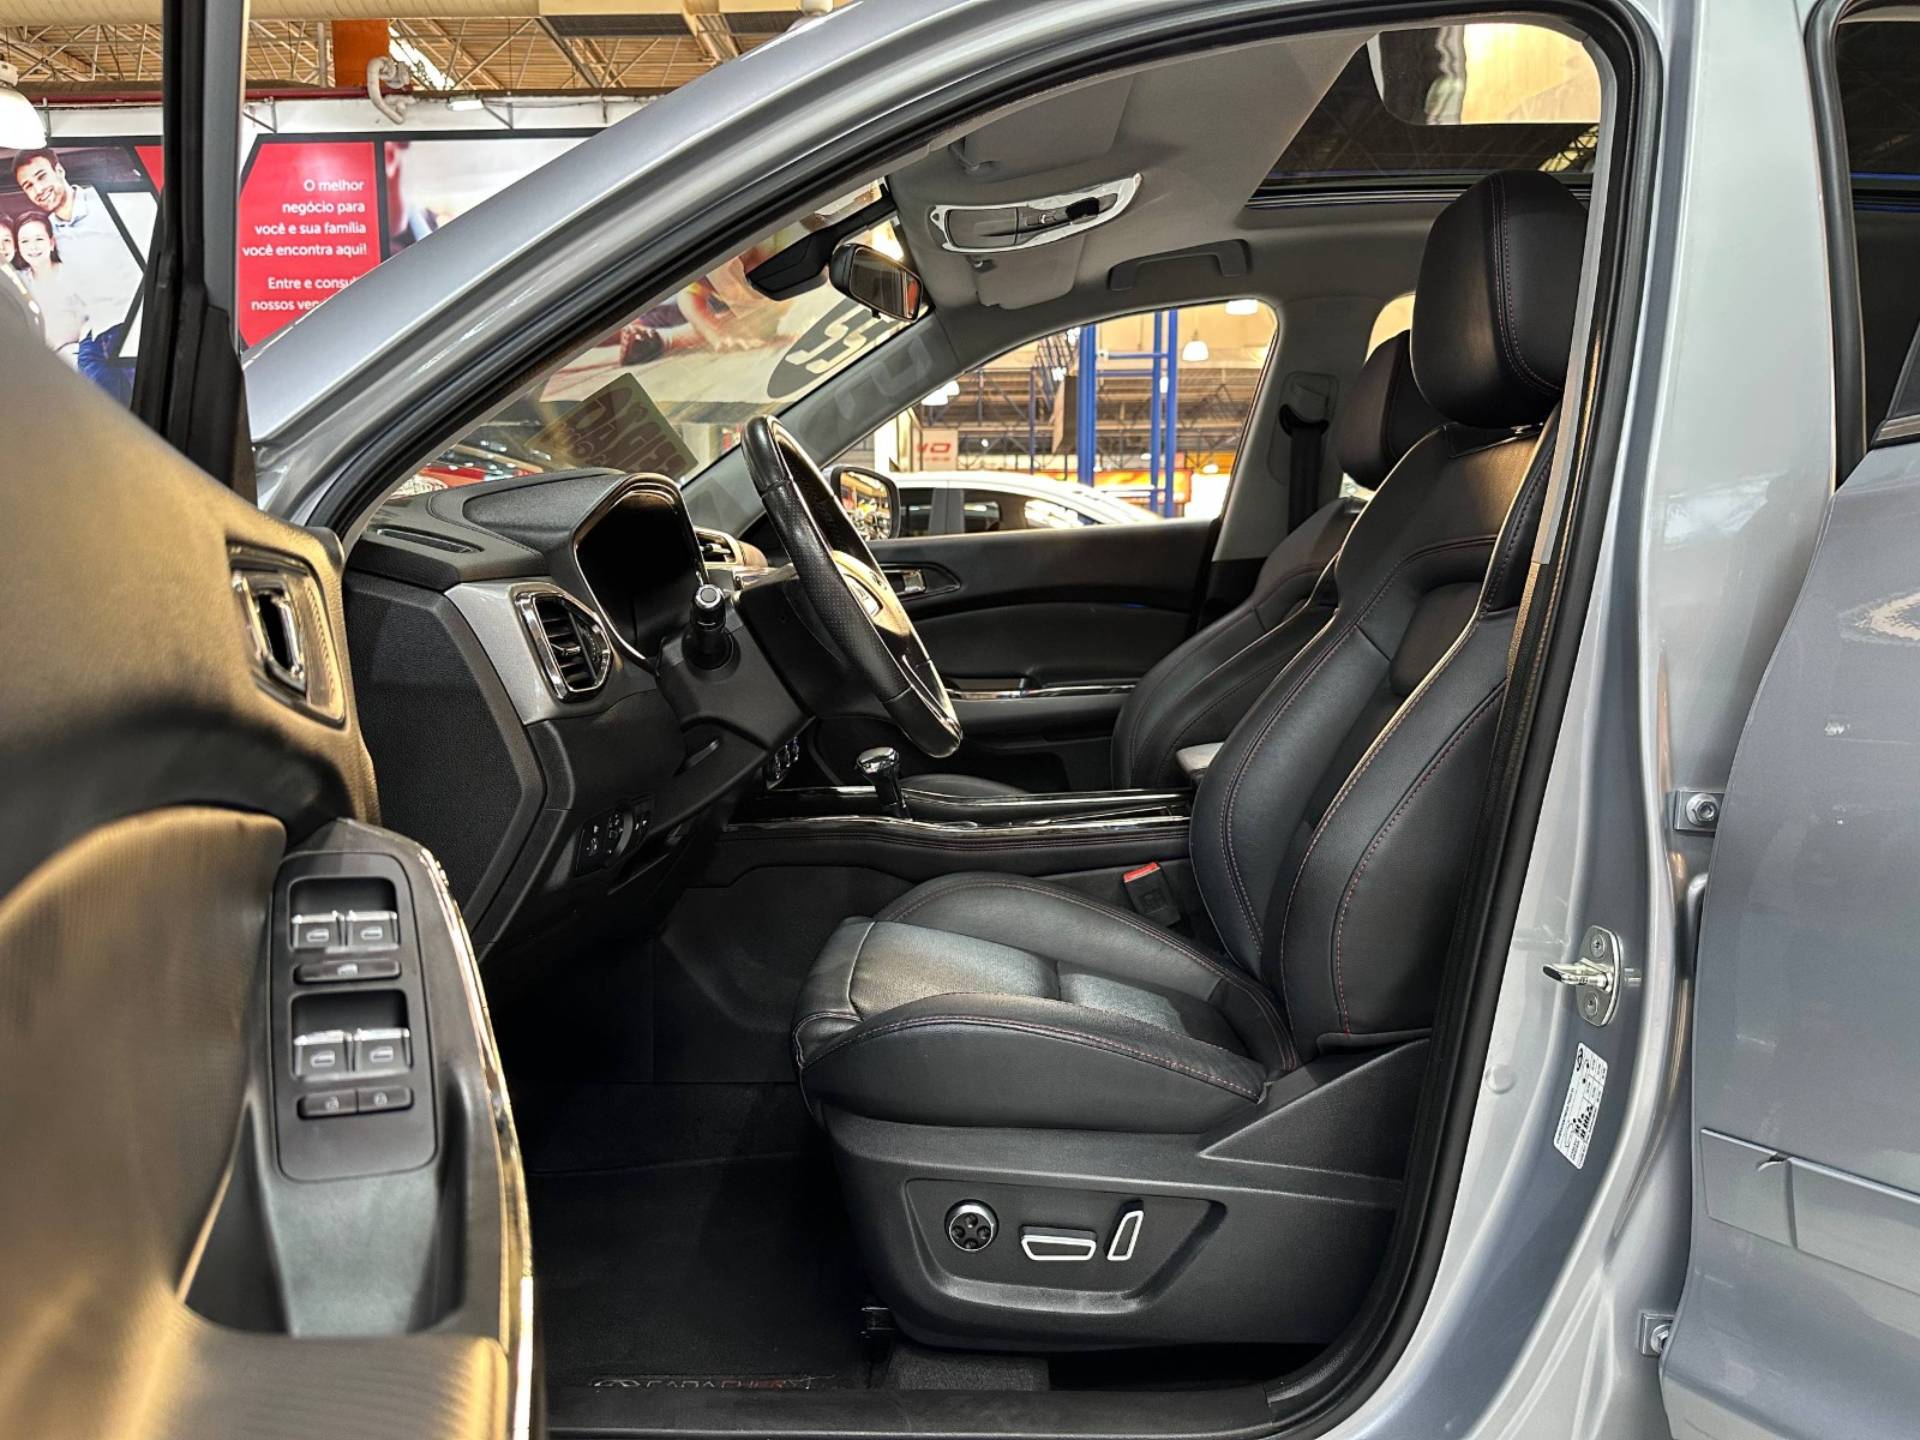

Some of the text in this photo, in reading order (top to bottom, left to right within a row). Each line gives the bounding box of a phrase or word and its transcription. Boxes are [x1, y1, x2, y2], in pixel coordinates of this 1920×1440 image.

[304, 179, 364, 191] O melhor
[282, 201, 365, 215] negócio para
[255, 222, 366, 234] você e sua família
[242, 243, 367, 258] você encontra aqui!
[268, 277, 301, 289] Entre
[304, 281, 312, 289] e
[251, 300, 295, 311] nossos
